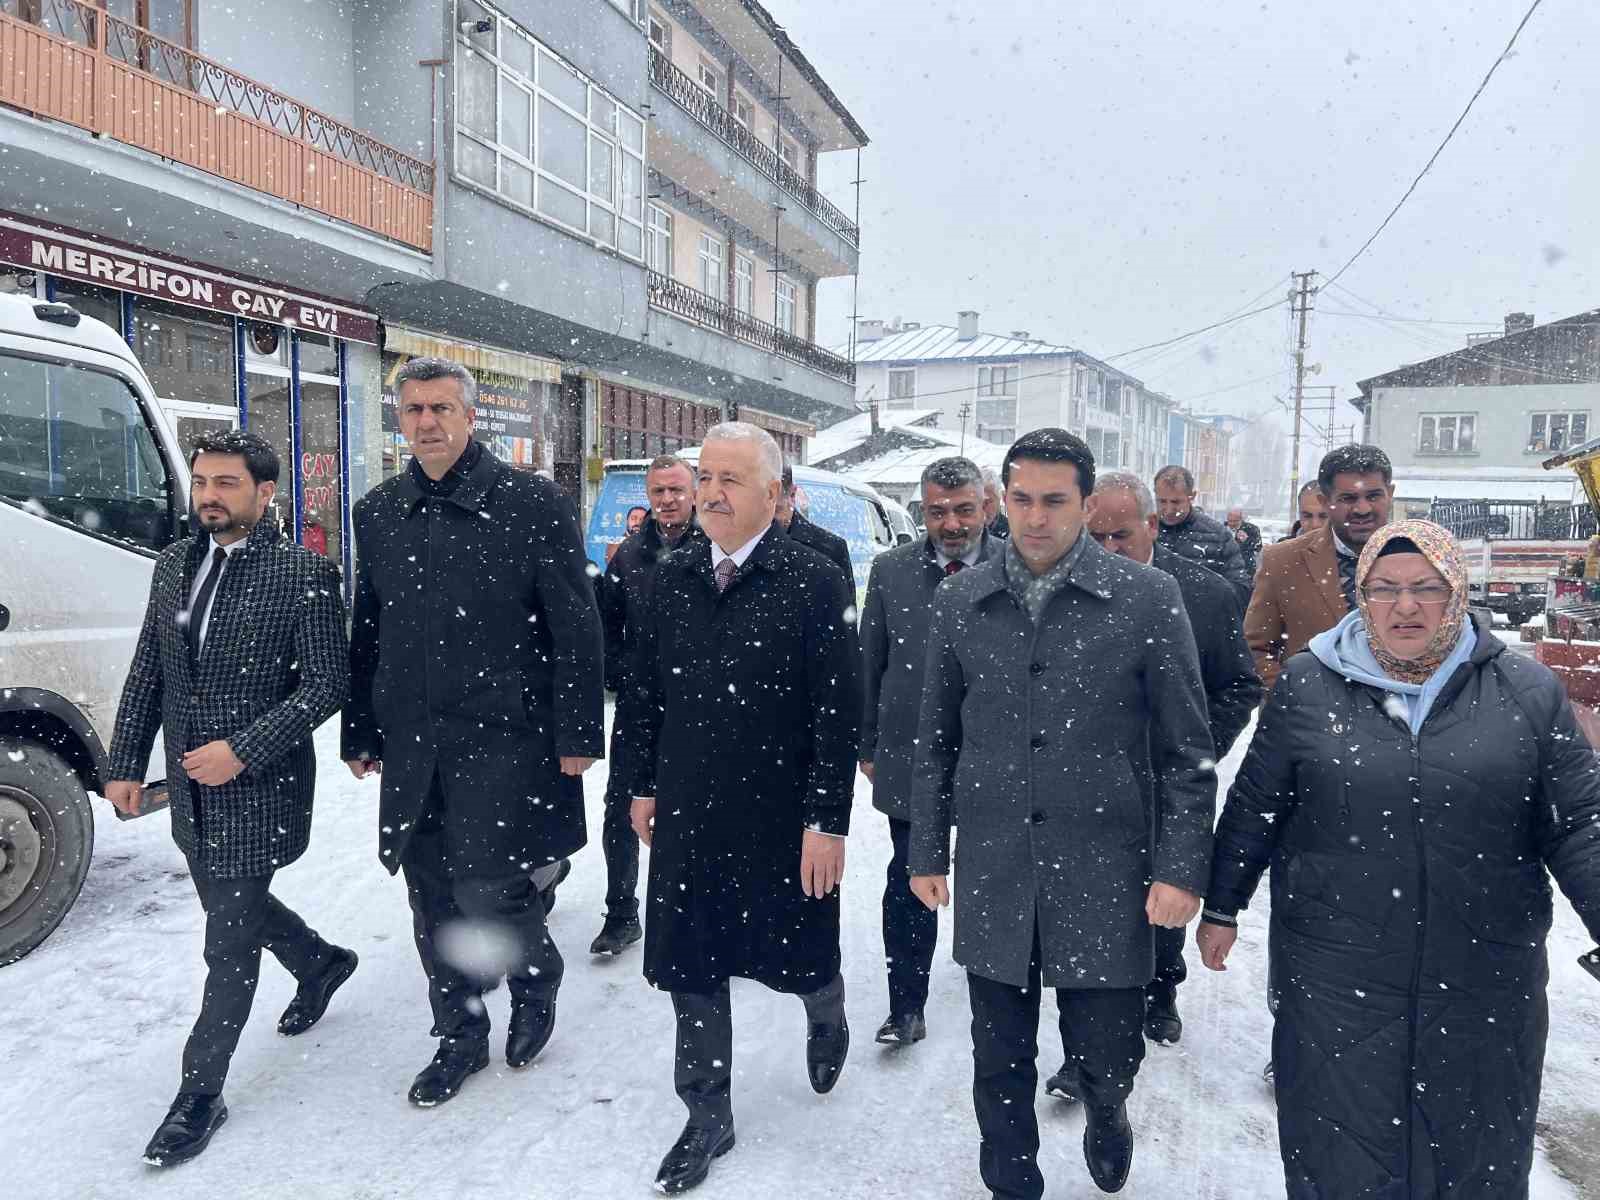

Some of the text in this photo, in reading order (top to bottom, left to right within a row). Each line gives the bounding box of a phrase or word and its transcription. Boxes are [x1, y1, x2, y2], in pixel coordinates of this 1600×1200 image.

[31, 240, 338, 332] MERZİFON ÇAY EVİ
[302, 452, 335, 481] ÇAY
